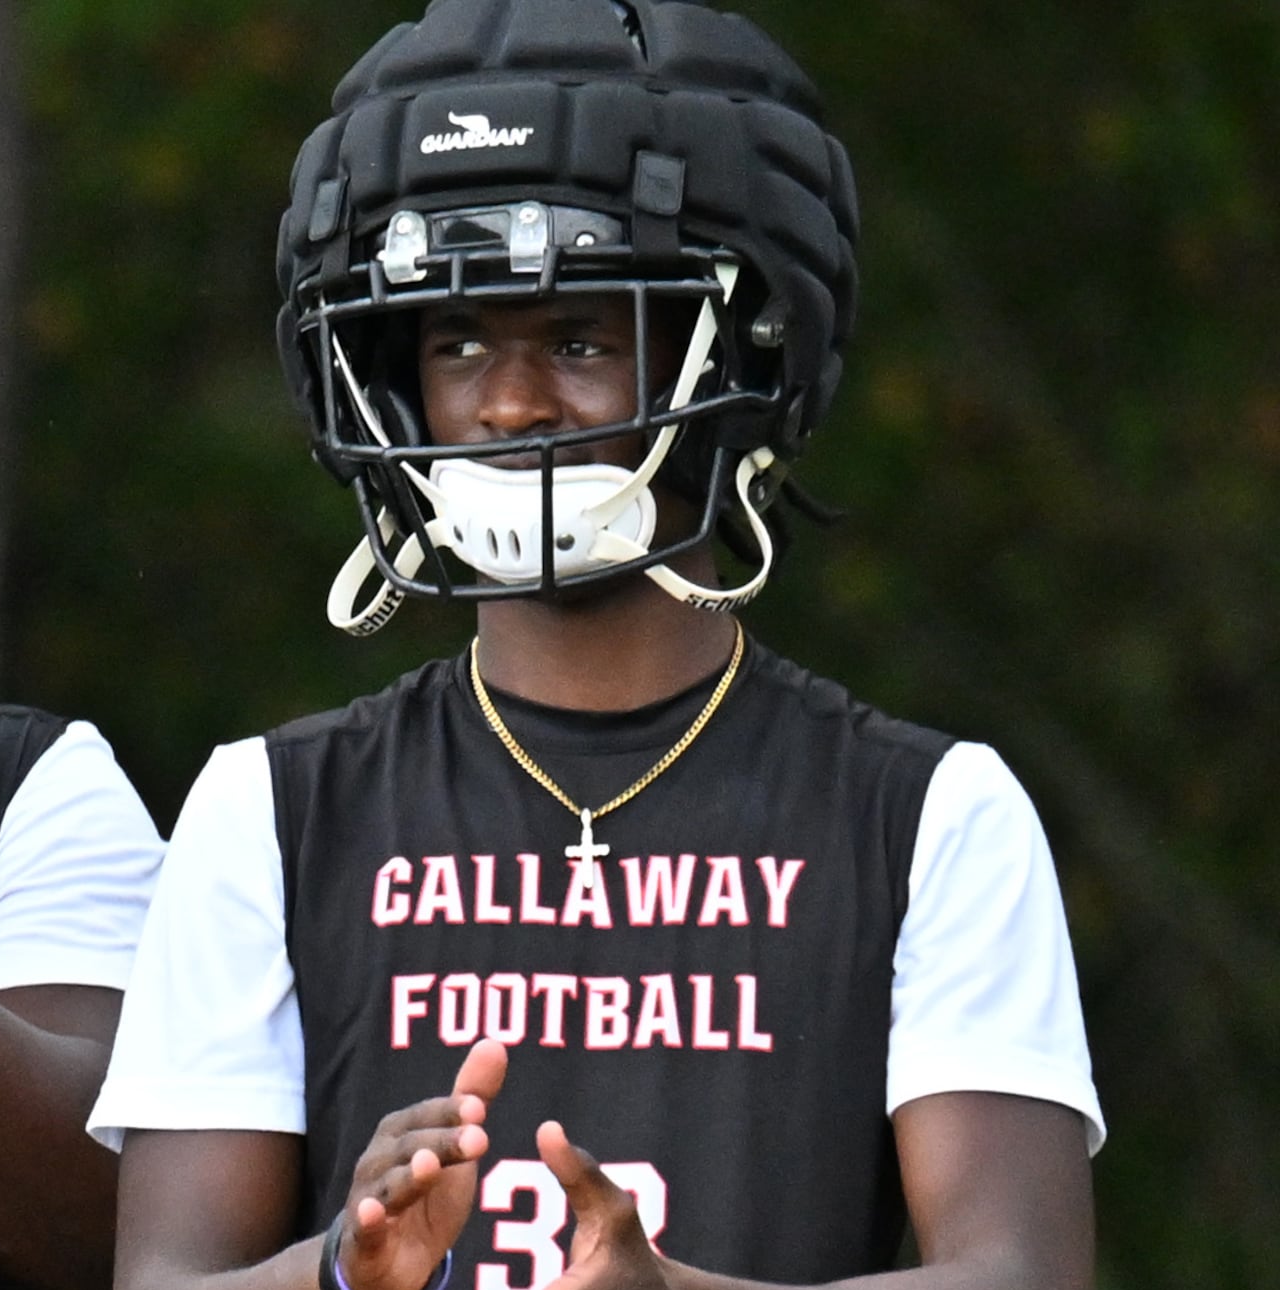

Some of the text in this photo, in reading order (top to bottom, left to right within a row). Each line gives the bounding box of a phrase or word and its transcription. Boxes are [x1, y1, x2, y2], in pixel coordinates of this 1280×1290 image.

[420, 127, 529, 154] GUARDIAN
[372, 854, 804, 928] CALLAWAY
[391, 972, 773, 1051] FOOTBALL
